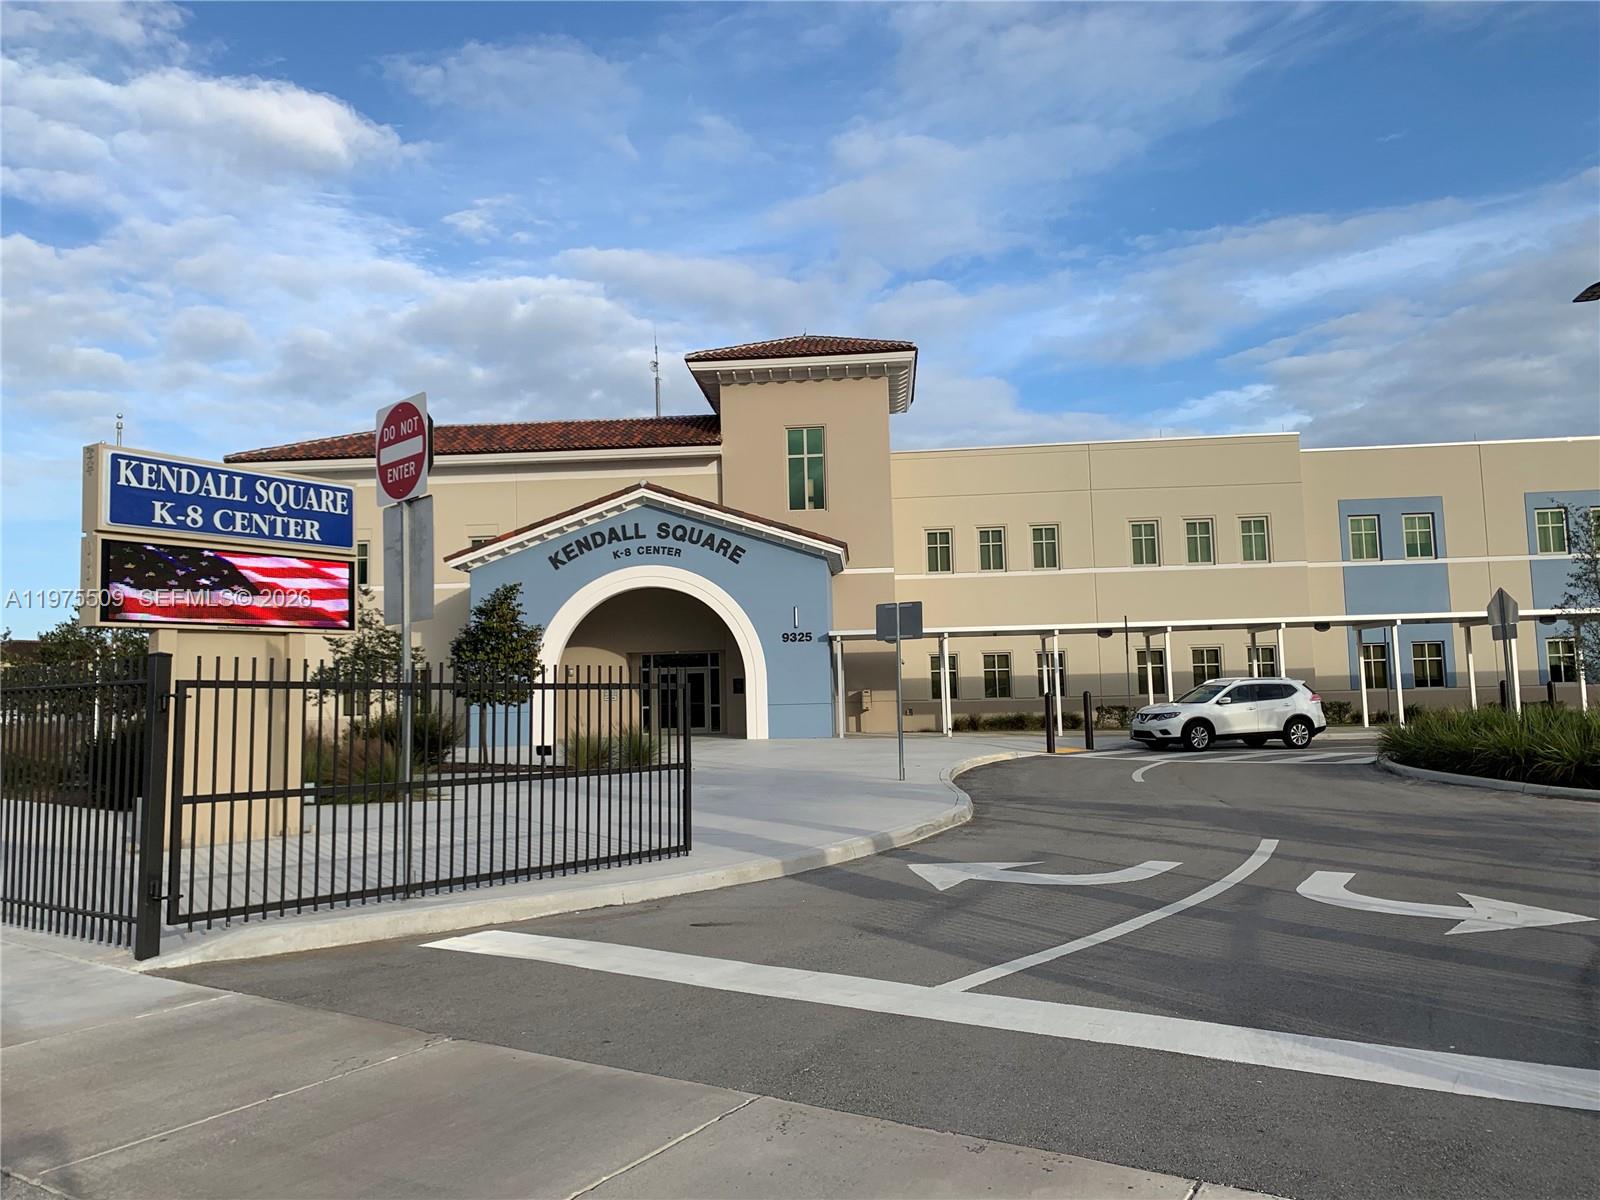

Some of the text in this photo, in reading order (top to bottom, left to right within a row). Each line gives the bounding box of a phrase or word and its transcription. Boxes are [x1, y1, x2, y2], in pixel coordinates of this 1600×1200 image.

[383, 416, 419, 442] DO NOT
[386, 461, 415, 484] ENTER
[116, 458, 349, 516] KENDALL SQUARE
[151, 500, 322, 542] K-8 CENTER
[547, 522, 746, 571] KENDALL SQUARE
[612, 545, 682, 560] K-8 CENTER
[781, 631, 813, 643] 9325
